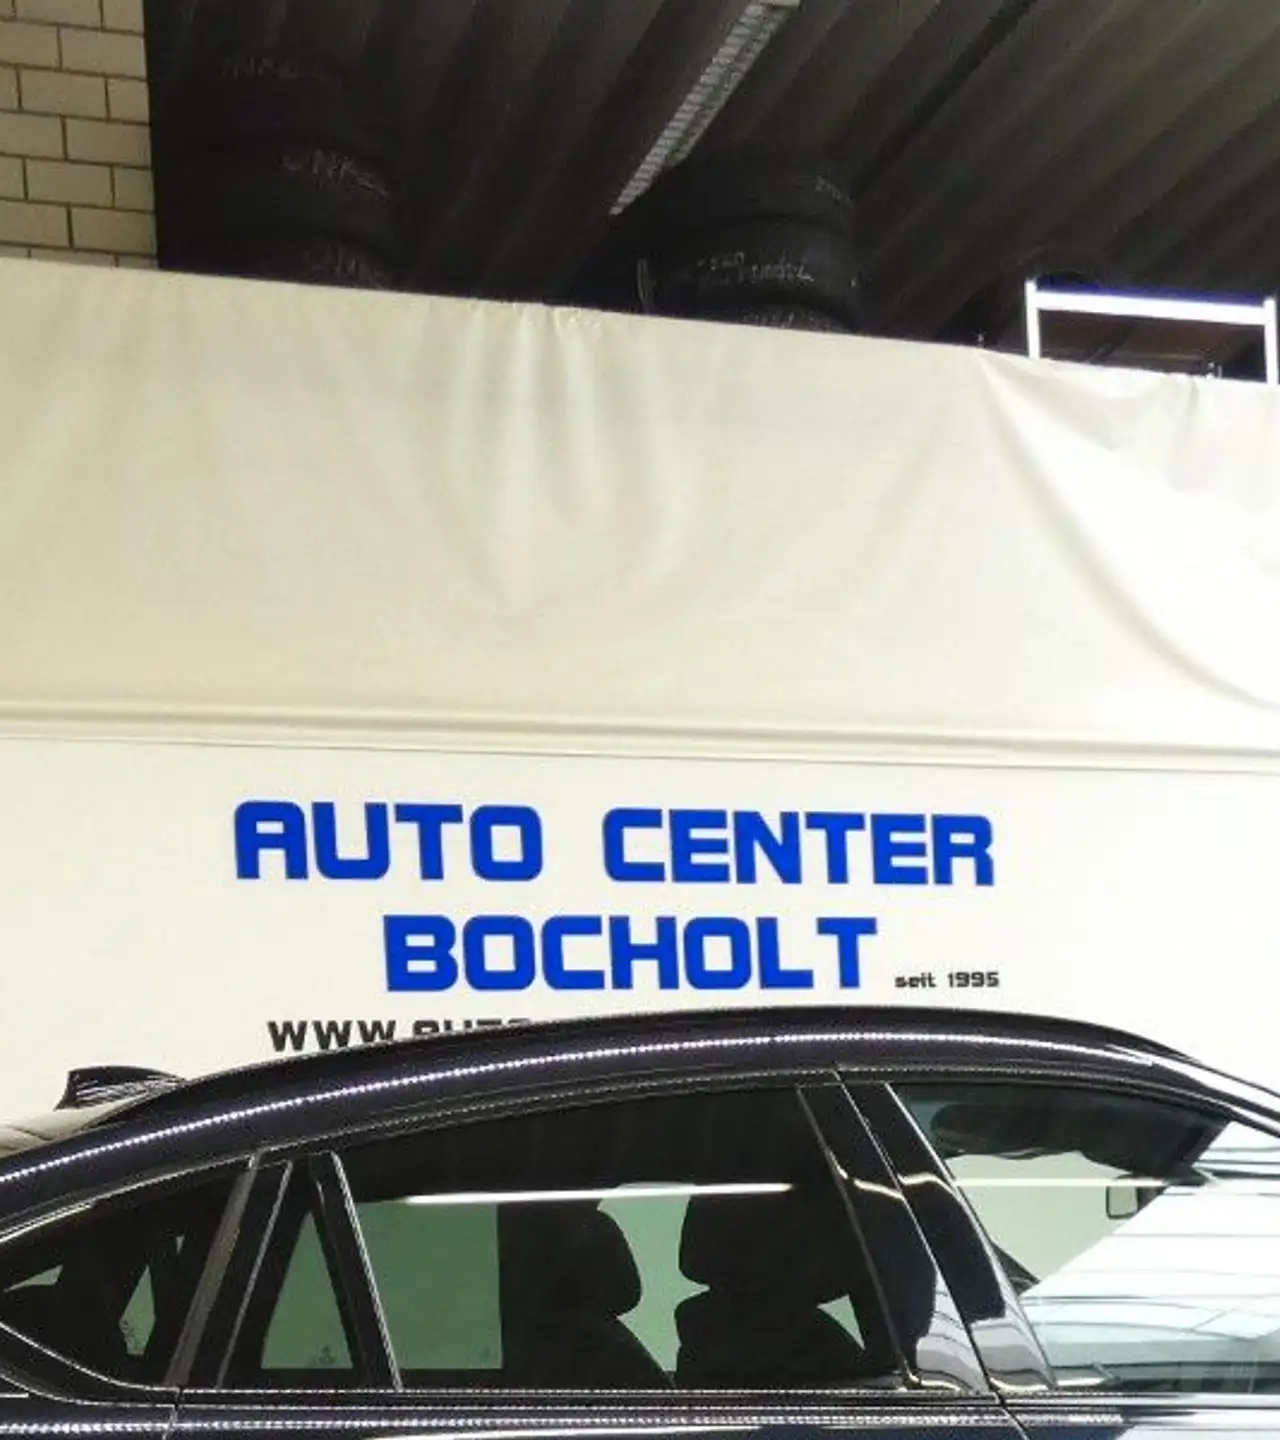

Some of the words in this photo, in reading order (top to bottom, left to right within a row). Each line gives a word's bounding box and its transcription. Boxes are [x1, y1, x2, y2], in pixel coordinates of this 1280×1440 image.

[234, 799, 544, 882] AUTO
[602, 806, 996, 887] CENTER
[383, 913, 878, 993] BOCHOLT
[894, 972, 937, 989] seit
[947, 971, 1000, 989] 1995
